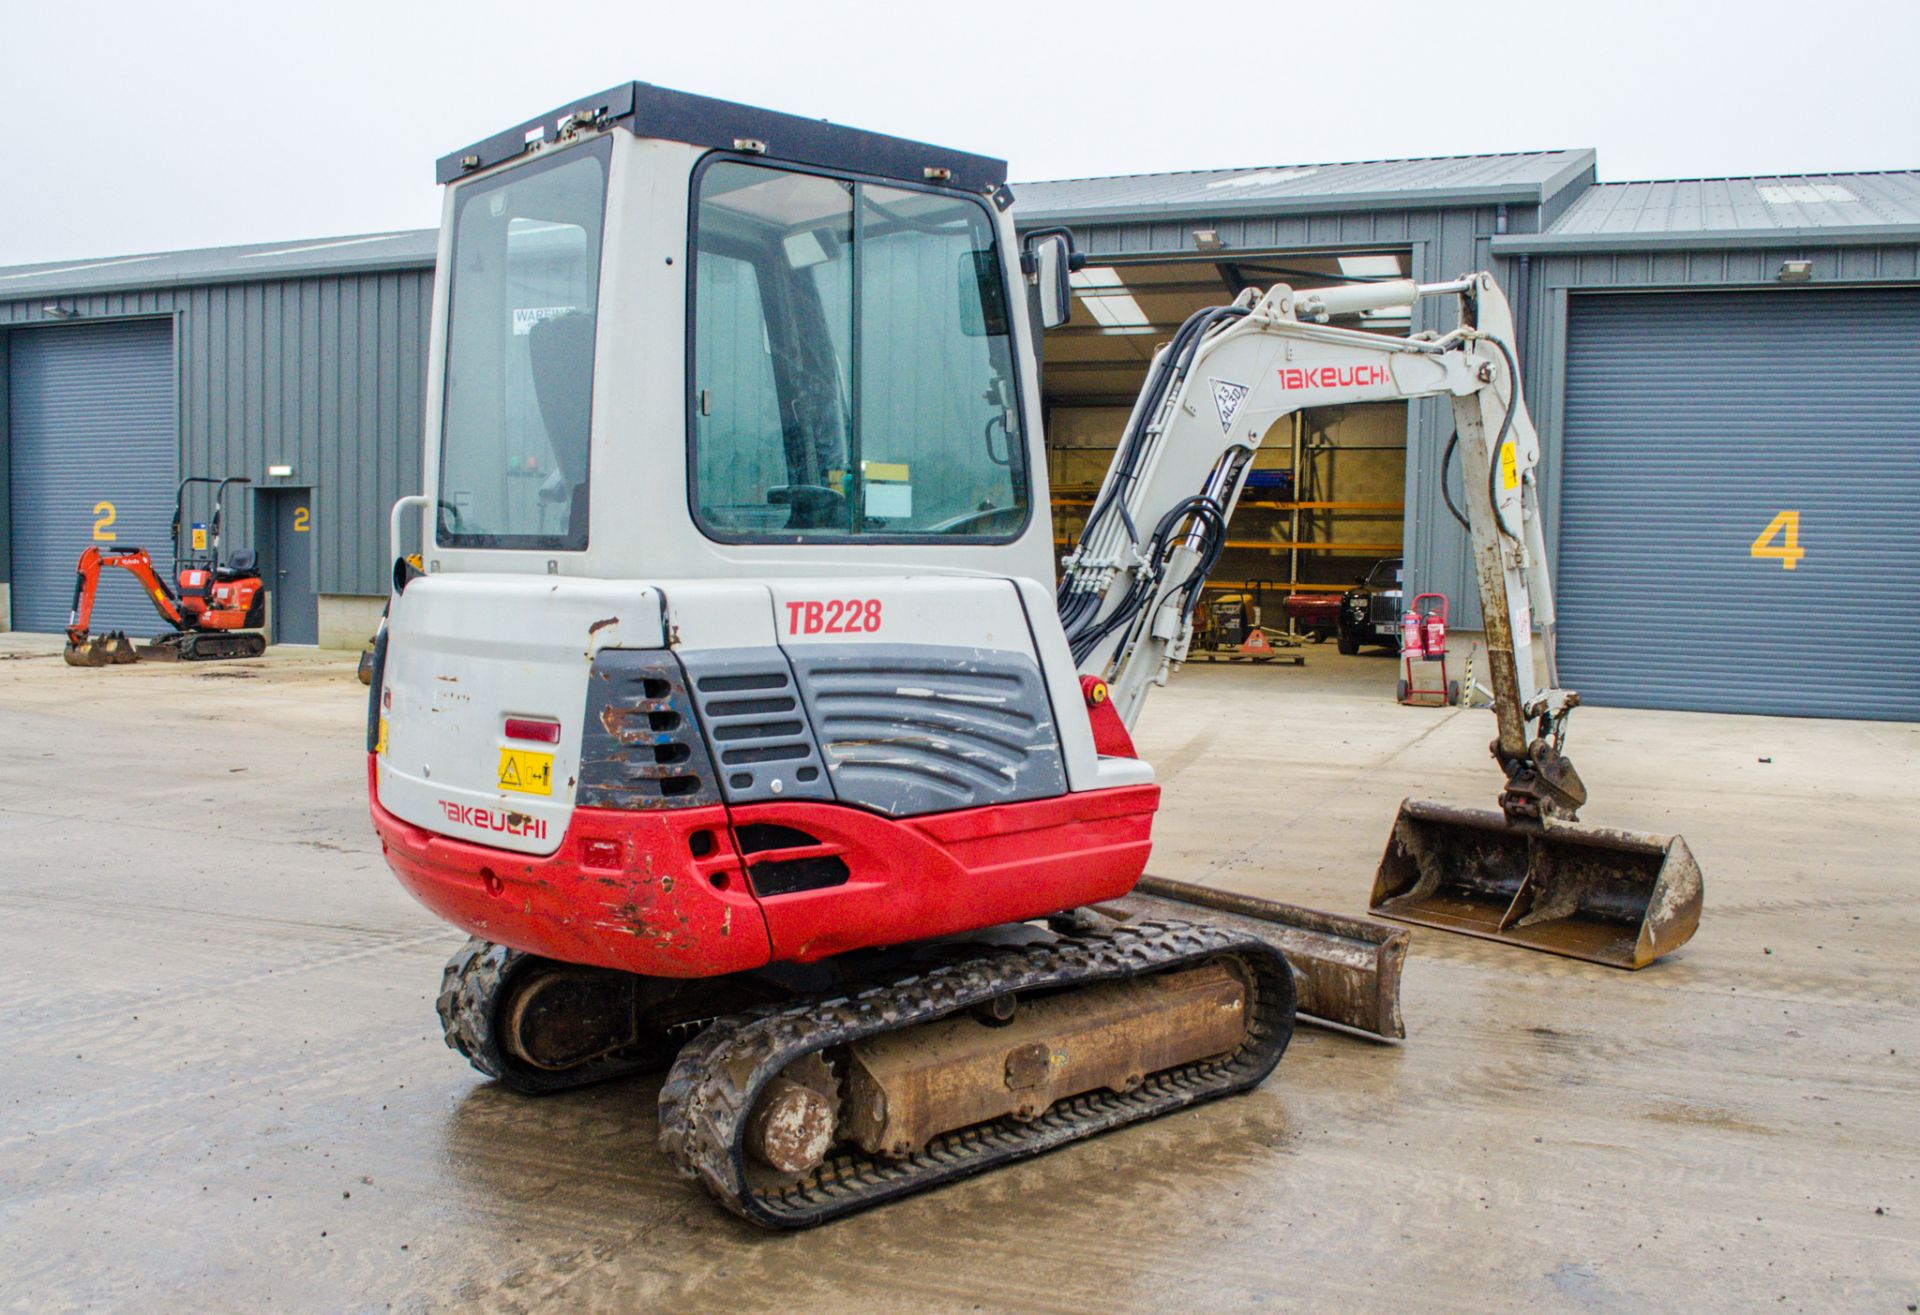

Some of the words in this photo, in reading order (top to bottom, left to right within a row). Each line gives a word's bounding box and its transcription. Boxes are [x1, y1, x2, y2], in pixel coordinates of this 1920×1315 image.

[93, 502, 115, 540] 2
[294, 507, 310, 532] 2
[1751, 511, 1804, 569] 4
[786, 599, 882, 635] TB228
